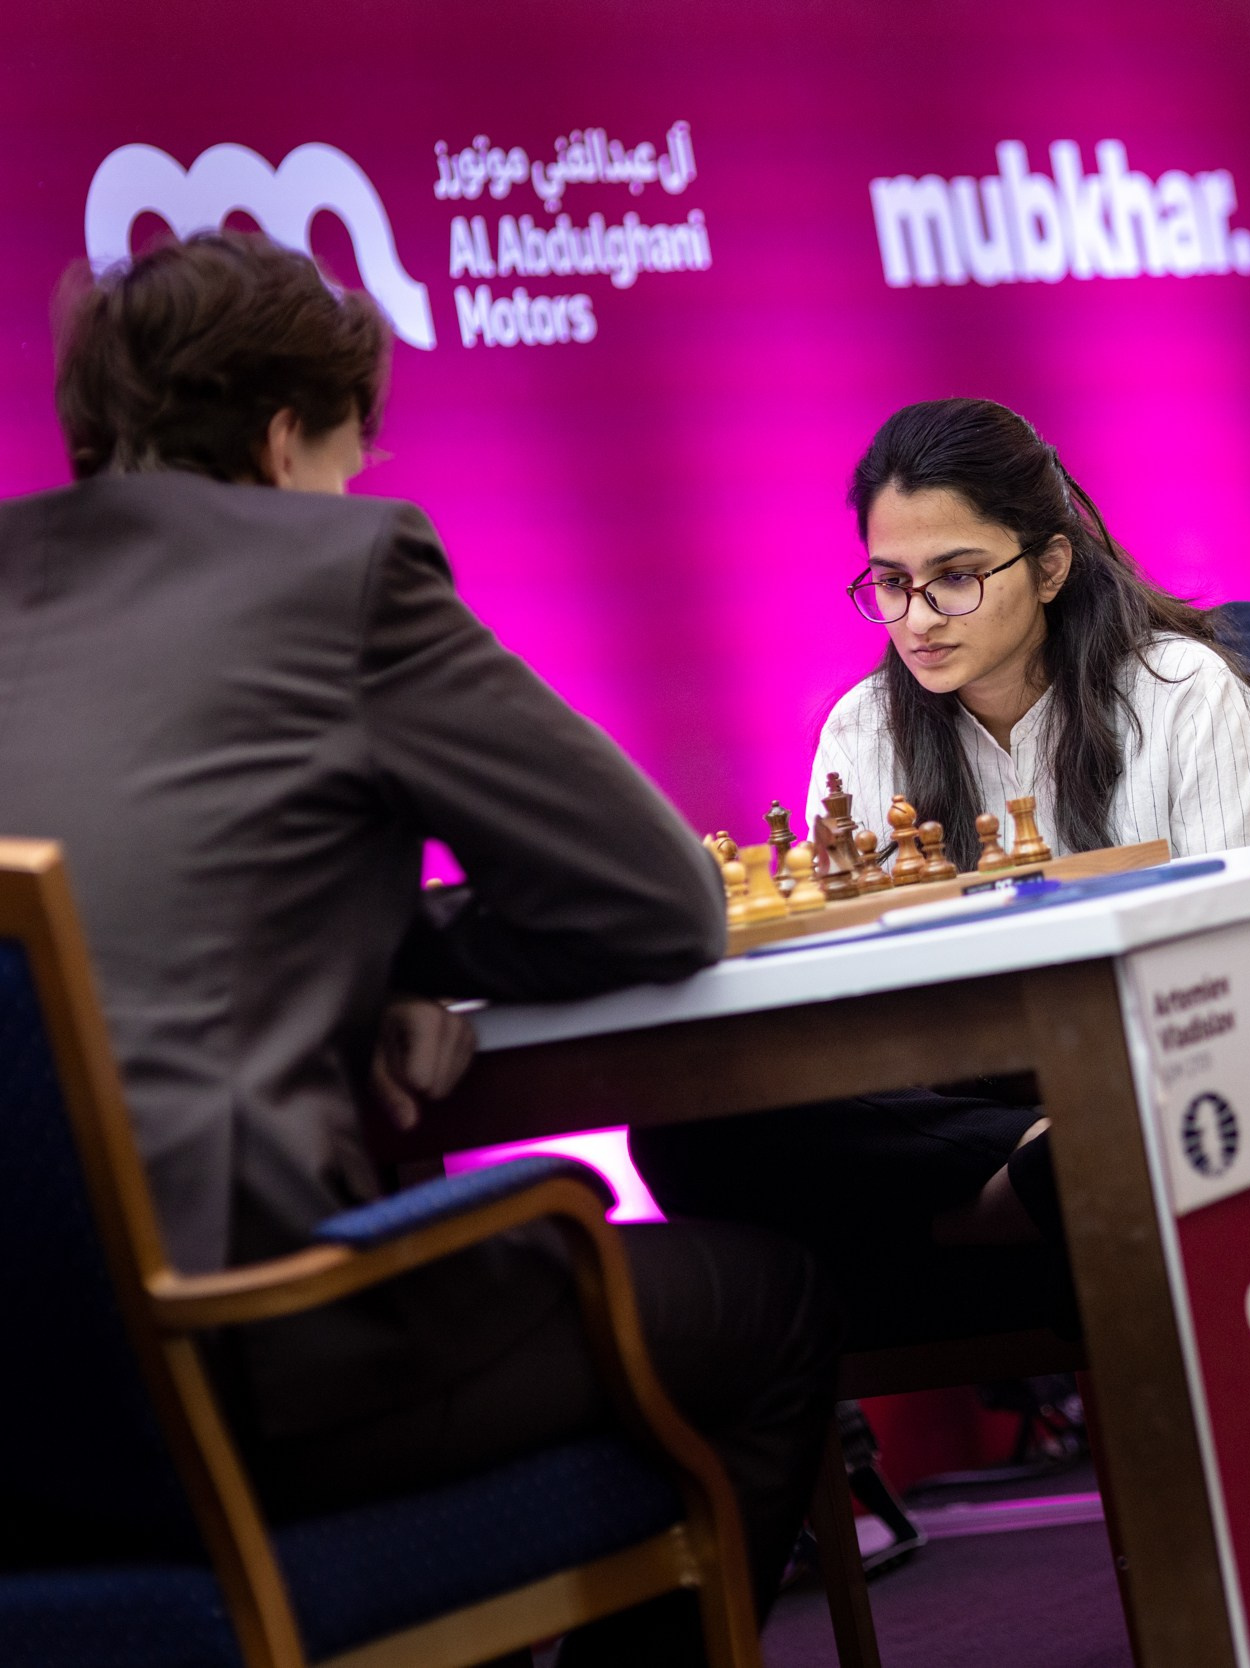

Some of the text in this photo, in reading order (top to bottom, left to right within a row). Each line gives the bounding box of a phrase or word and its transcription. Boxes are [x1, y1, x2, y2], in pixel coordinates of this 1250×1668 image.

[449, 208, 712, 289] Al Abdulghani
[454, 284, 599, 348] Motors
